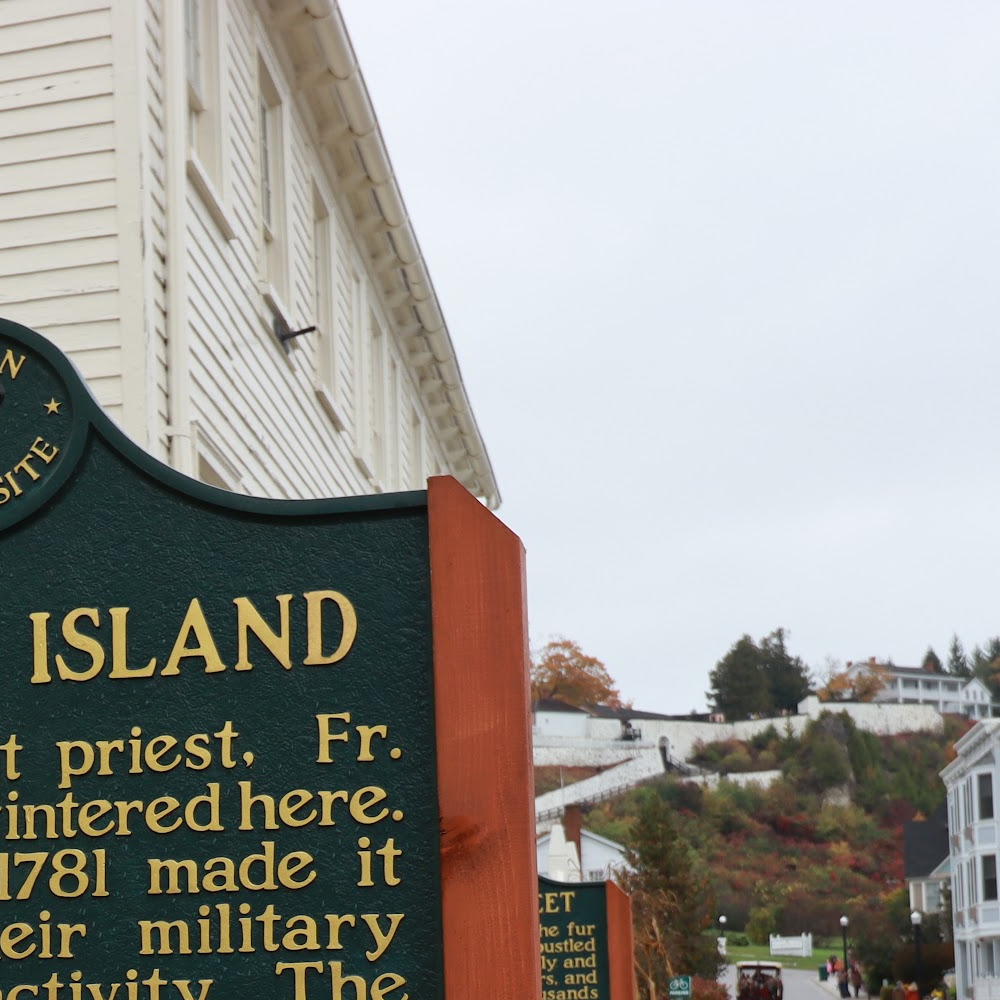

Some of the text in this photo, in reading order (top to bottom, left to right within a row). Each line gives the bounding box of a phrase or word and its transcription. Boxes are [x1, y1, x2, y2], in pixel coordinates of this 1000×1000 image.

[29, 590, 357, 683] ISLAND
[56, 721, 254, 789] priest,
[316, 712, 401, 763] Fr.
[238, 781, 403, 830] here.
[148, 841, 316, 894] made
[358, 837, 402, 886] it
[538, 891, 576, 913] ET
[138, 904, 404, 961] military
[567, 921, 596, 936] fur
[563, 953, 597, 968] and
[564, 969, 598, 985] and
